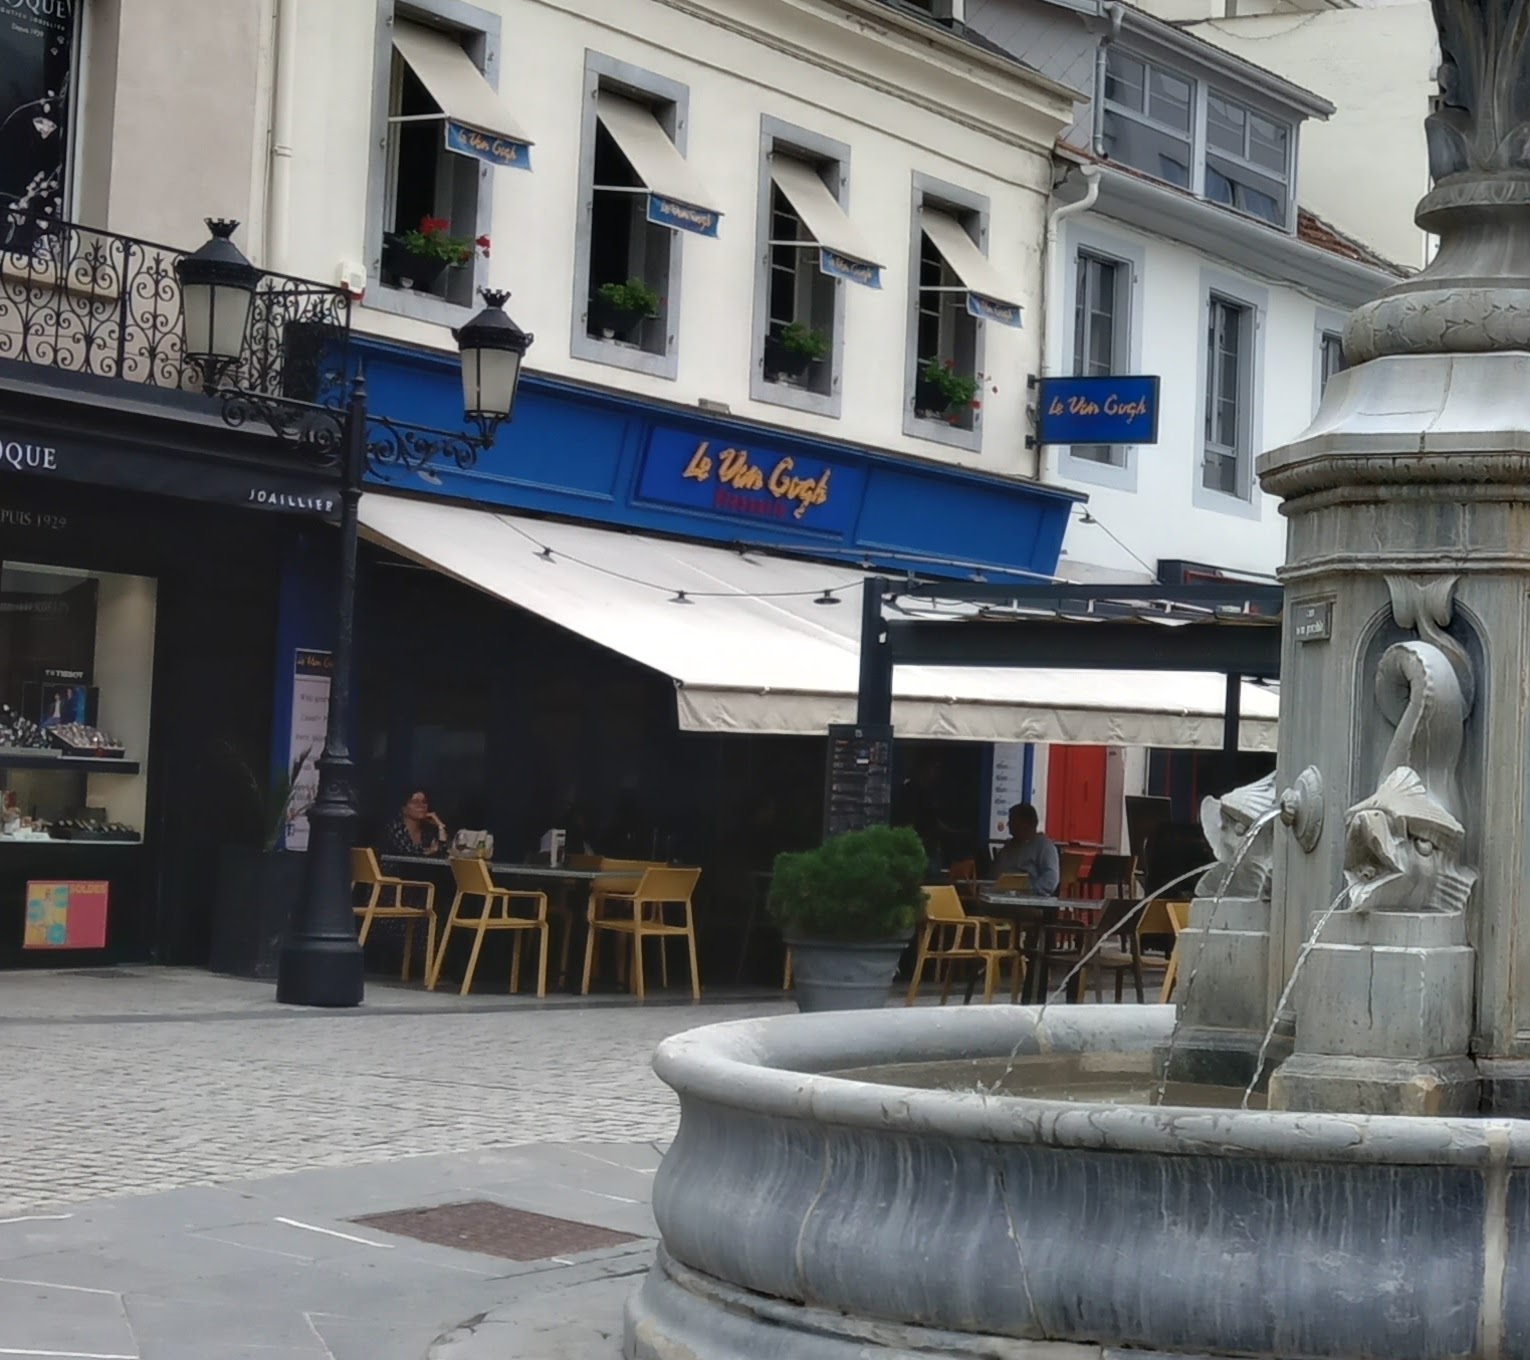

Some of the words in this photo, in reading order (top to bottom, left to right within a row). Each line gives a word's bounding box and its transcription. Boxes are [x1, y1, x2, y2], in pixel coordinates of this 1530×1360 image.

[1048, 395, 1064, 416] Le
[1067, 396, 1100, 416] Van
[1103, 393, 1147, 425] Gogh
[682, 441, 712, 482] Le
[718, 448, 764, 491] Van
[768, 456, 832, 520] Gogh
[248, 488, 334, 513] JOAILLIER
